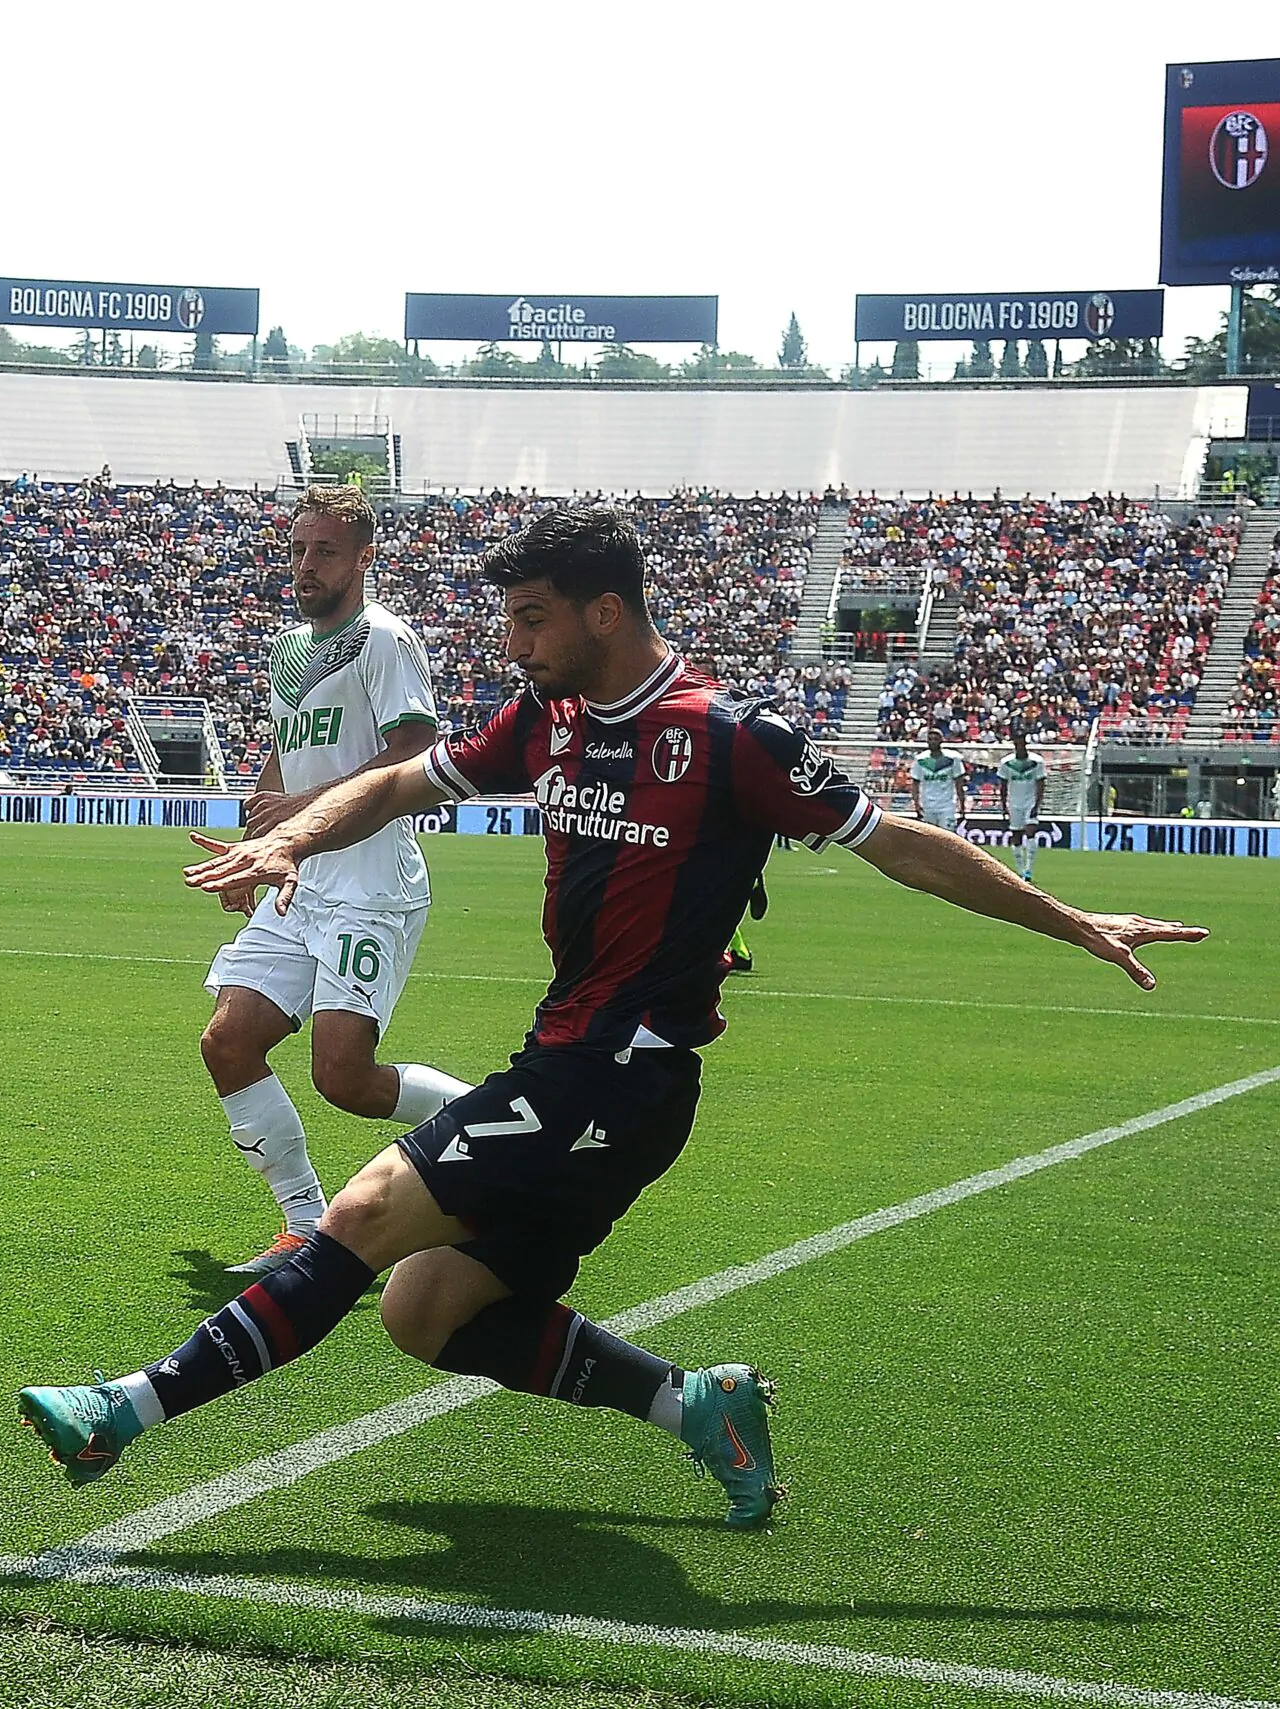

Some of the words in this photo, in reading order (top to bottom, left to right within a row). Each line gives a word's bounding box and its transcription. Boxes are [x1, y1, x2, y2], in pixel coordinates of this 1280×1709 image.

[11, 288, 94, 318] BOLOGNA
[99, 292, 121, 319] FC
[124, 293, 171, 321] 1909
[904, 301, 994, 331] BOLOGNA
[999, 301, 1024, 330] FC
[1027, 300, 1078, 330] 1909
[509, 321, 616, 339] ristrutturare
[666, 728, 684, 739] BFC
[584, 741, 634, 760] Selenella
[533, 765, 625, 813] facile
[49, 797, 68, 824] DI
[75, 797, 130, 826] UTENTI
[136, 799, 152, 827] AL
[161, 800, 207, 828] MONDO
[486, 807, 512, 834] 25
[1104, 824, 1134, 852] 25
[1147, 825, 1235, 856] MILIONI
[1248, 828, 1268, 857] DI
[336, 933, 382, 983] 16
[463, 1096, 542, 1138] 7
